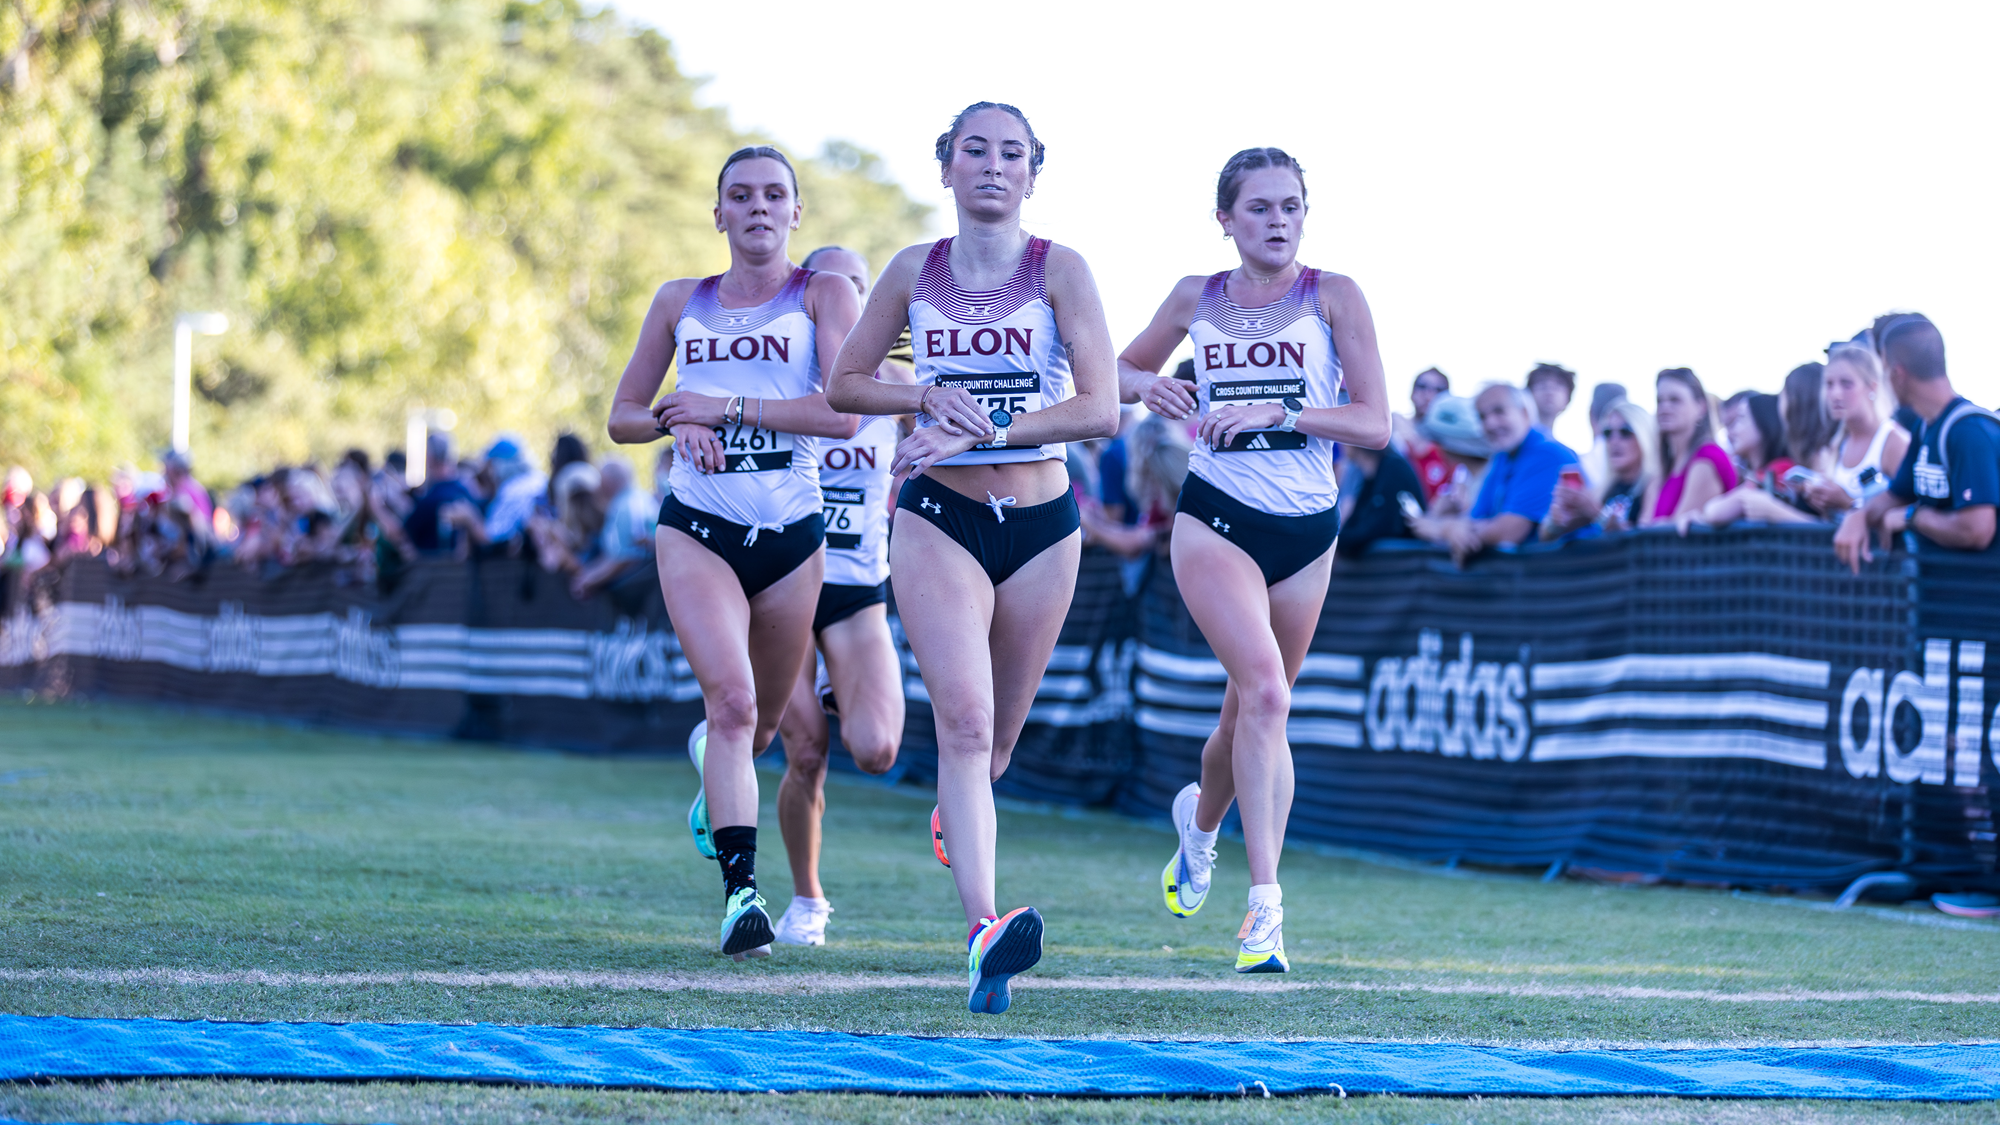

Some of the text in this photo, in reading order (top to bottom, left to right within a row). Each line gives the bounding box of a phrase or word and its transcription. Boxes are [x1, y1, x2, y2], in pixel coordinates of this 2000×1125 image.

[685, 335, 791, 365] ELON
[925, 327, 1034, 358] ELON
[1203, 341, 1307, 371] ELON
[963, 379, 993, 390] COUNTRY
[993, 378, 1034, 389] CHALLENGE
[1215, 384, 1301, 397] CROSS COUNTRY CHALLENGE
[977, 396, 1027, 414] 75
[713, 425, 777, 452] 3461
[818, 446, 877, 471] ON
[1366, 627, 1530, 763] adidas
[1838, 637, 2000, 788] adi
